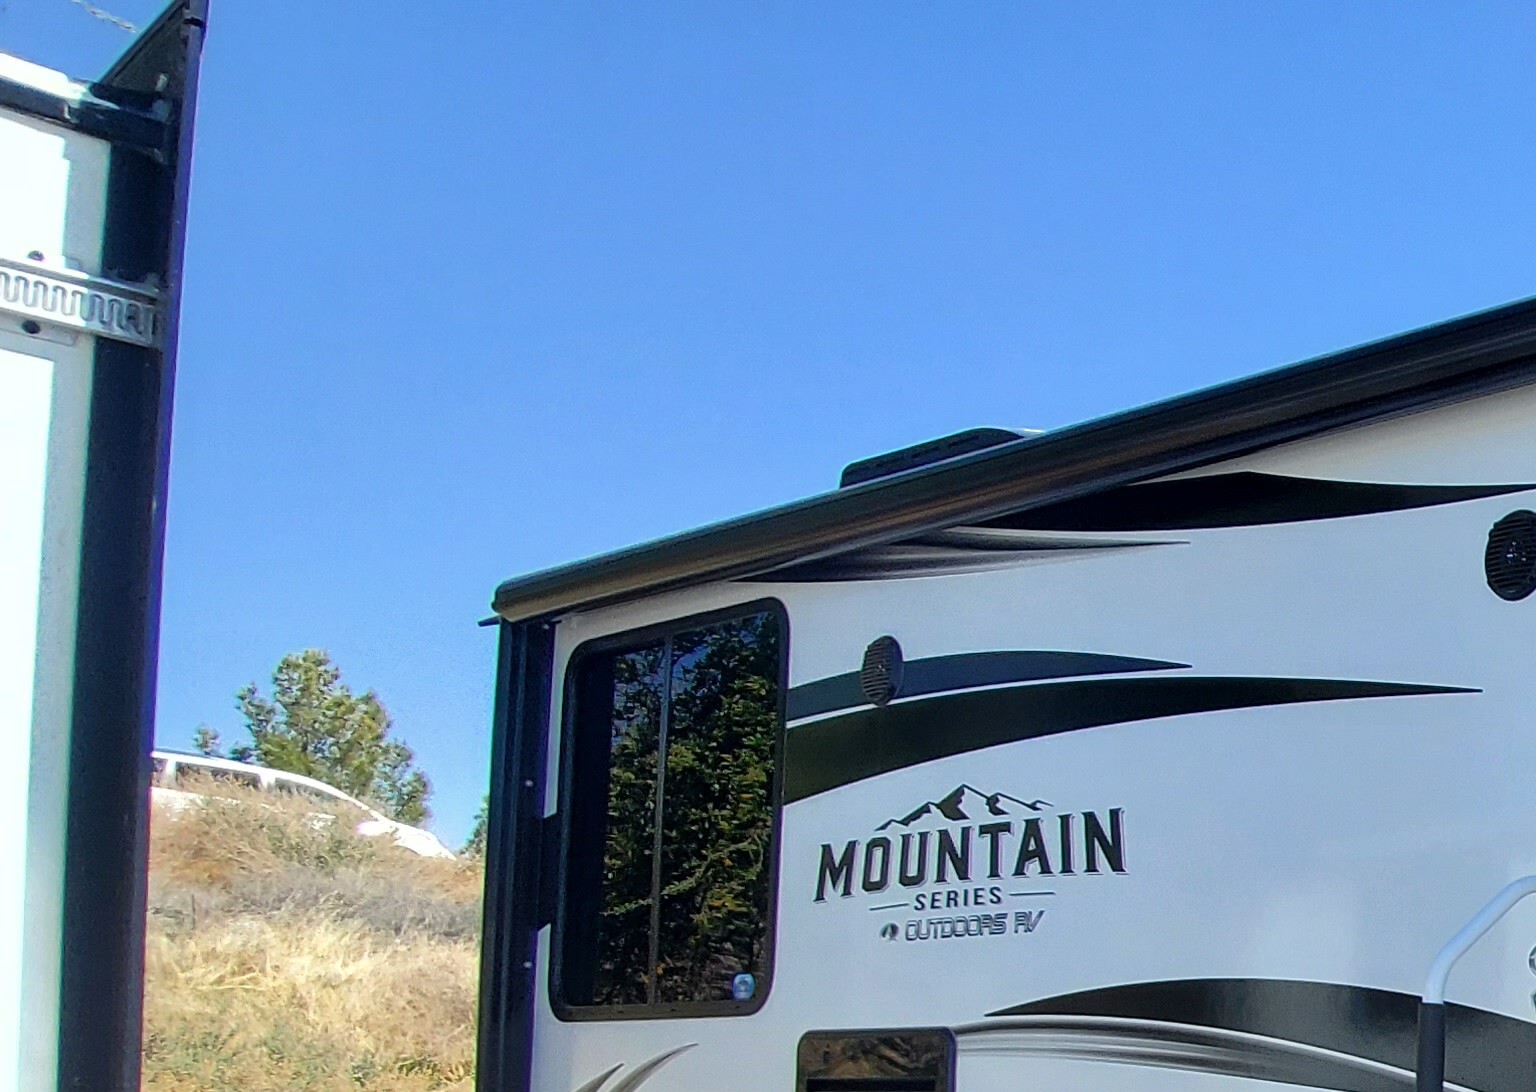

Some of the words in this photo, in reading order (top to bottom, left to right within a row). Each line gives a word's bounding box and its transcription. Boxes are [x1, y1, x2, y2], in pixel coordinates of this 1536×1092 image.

[813, 808, 1129, 904] MOUNTAIN
[913, 886, 1003, 911] SERIES
[904, 912, 1008, 942] OUTDOORS
[1013, 909, 1046, 935] RV
